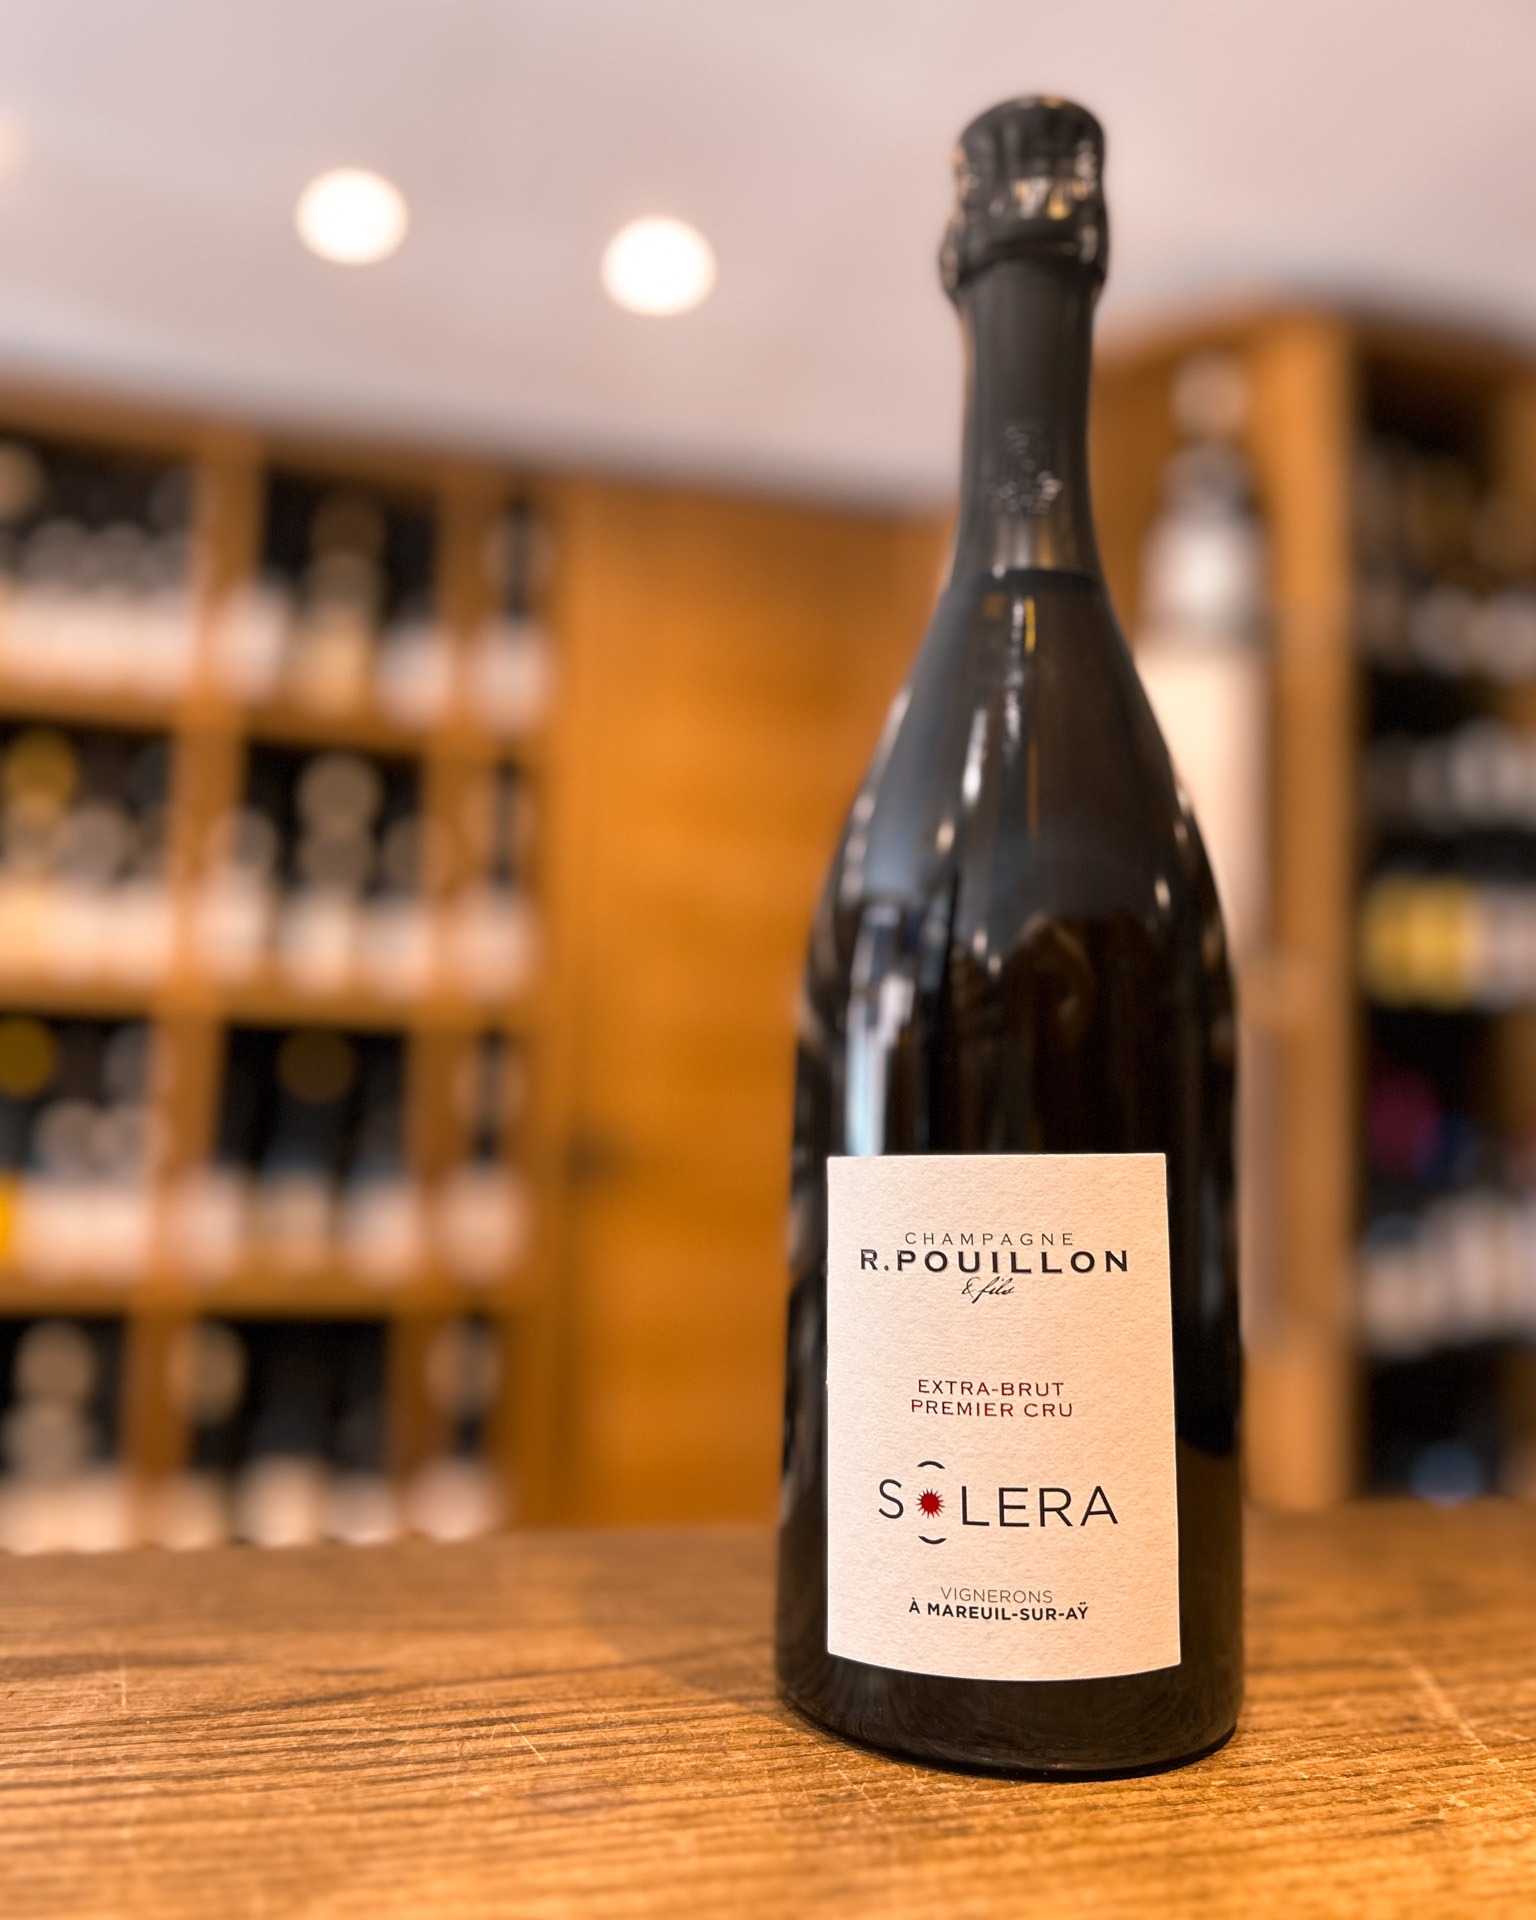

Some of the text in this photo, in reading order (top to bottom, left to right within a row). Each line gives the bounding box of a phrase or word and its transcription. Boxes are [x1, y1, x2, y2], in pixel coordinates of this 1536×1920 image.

[905, 1231, 1074, 1246] CHAMPAGNE
[860, 1248, 1128, 1275] R.POUILLON
[961, 1275, 1015, 1304] & fils
[918, 1379, 1065, 1397] EXTRA-BRUT
[911, 1399, 1073, 1418] PREMIER CRU
[940, 1587, 1053, 1604] VIGNERONS
[908, 1596, 1089, 1622] À MAREUIL-SUR-AŸ
